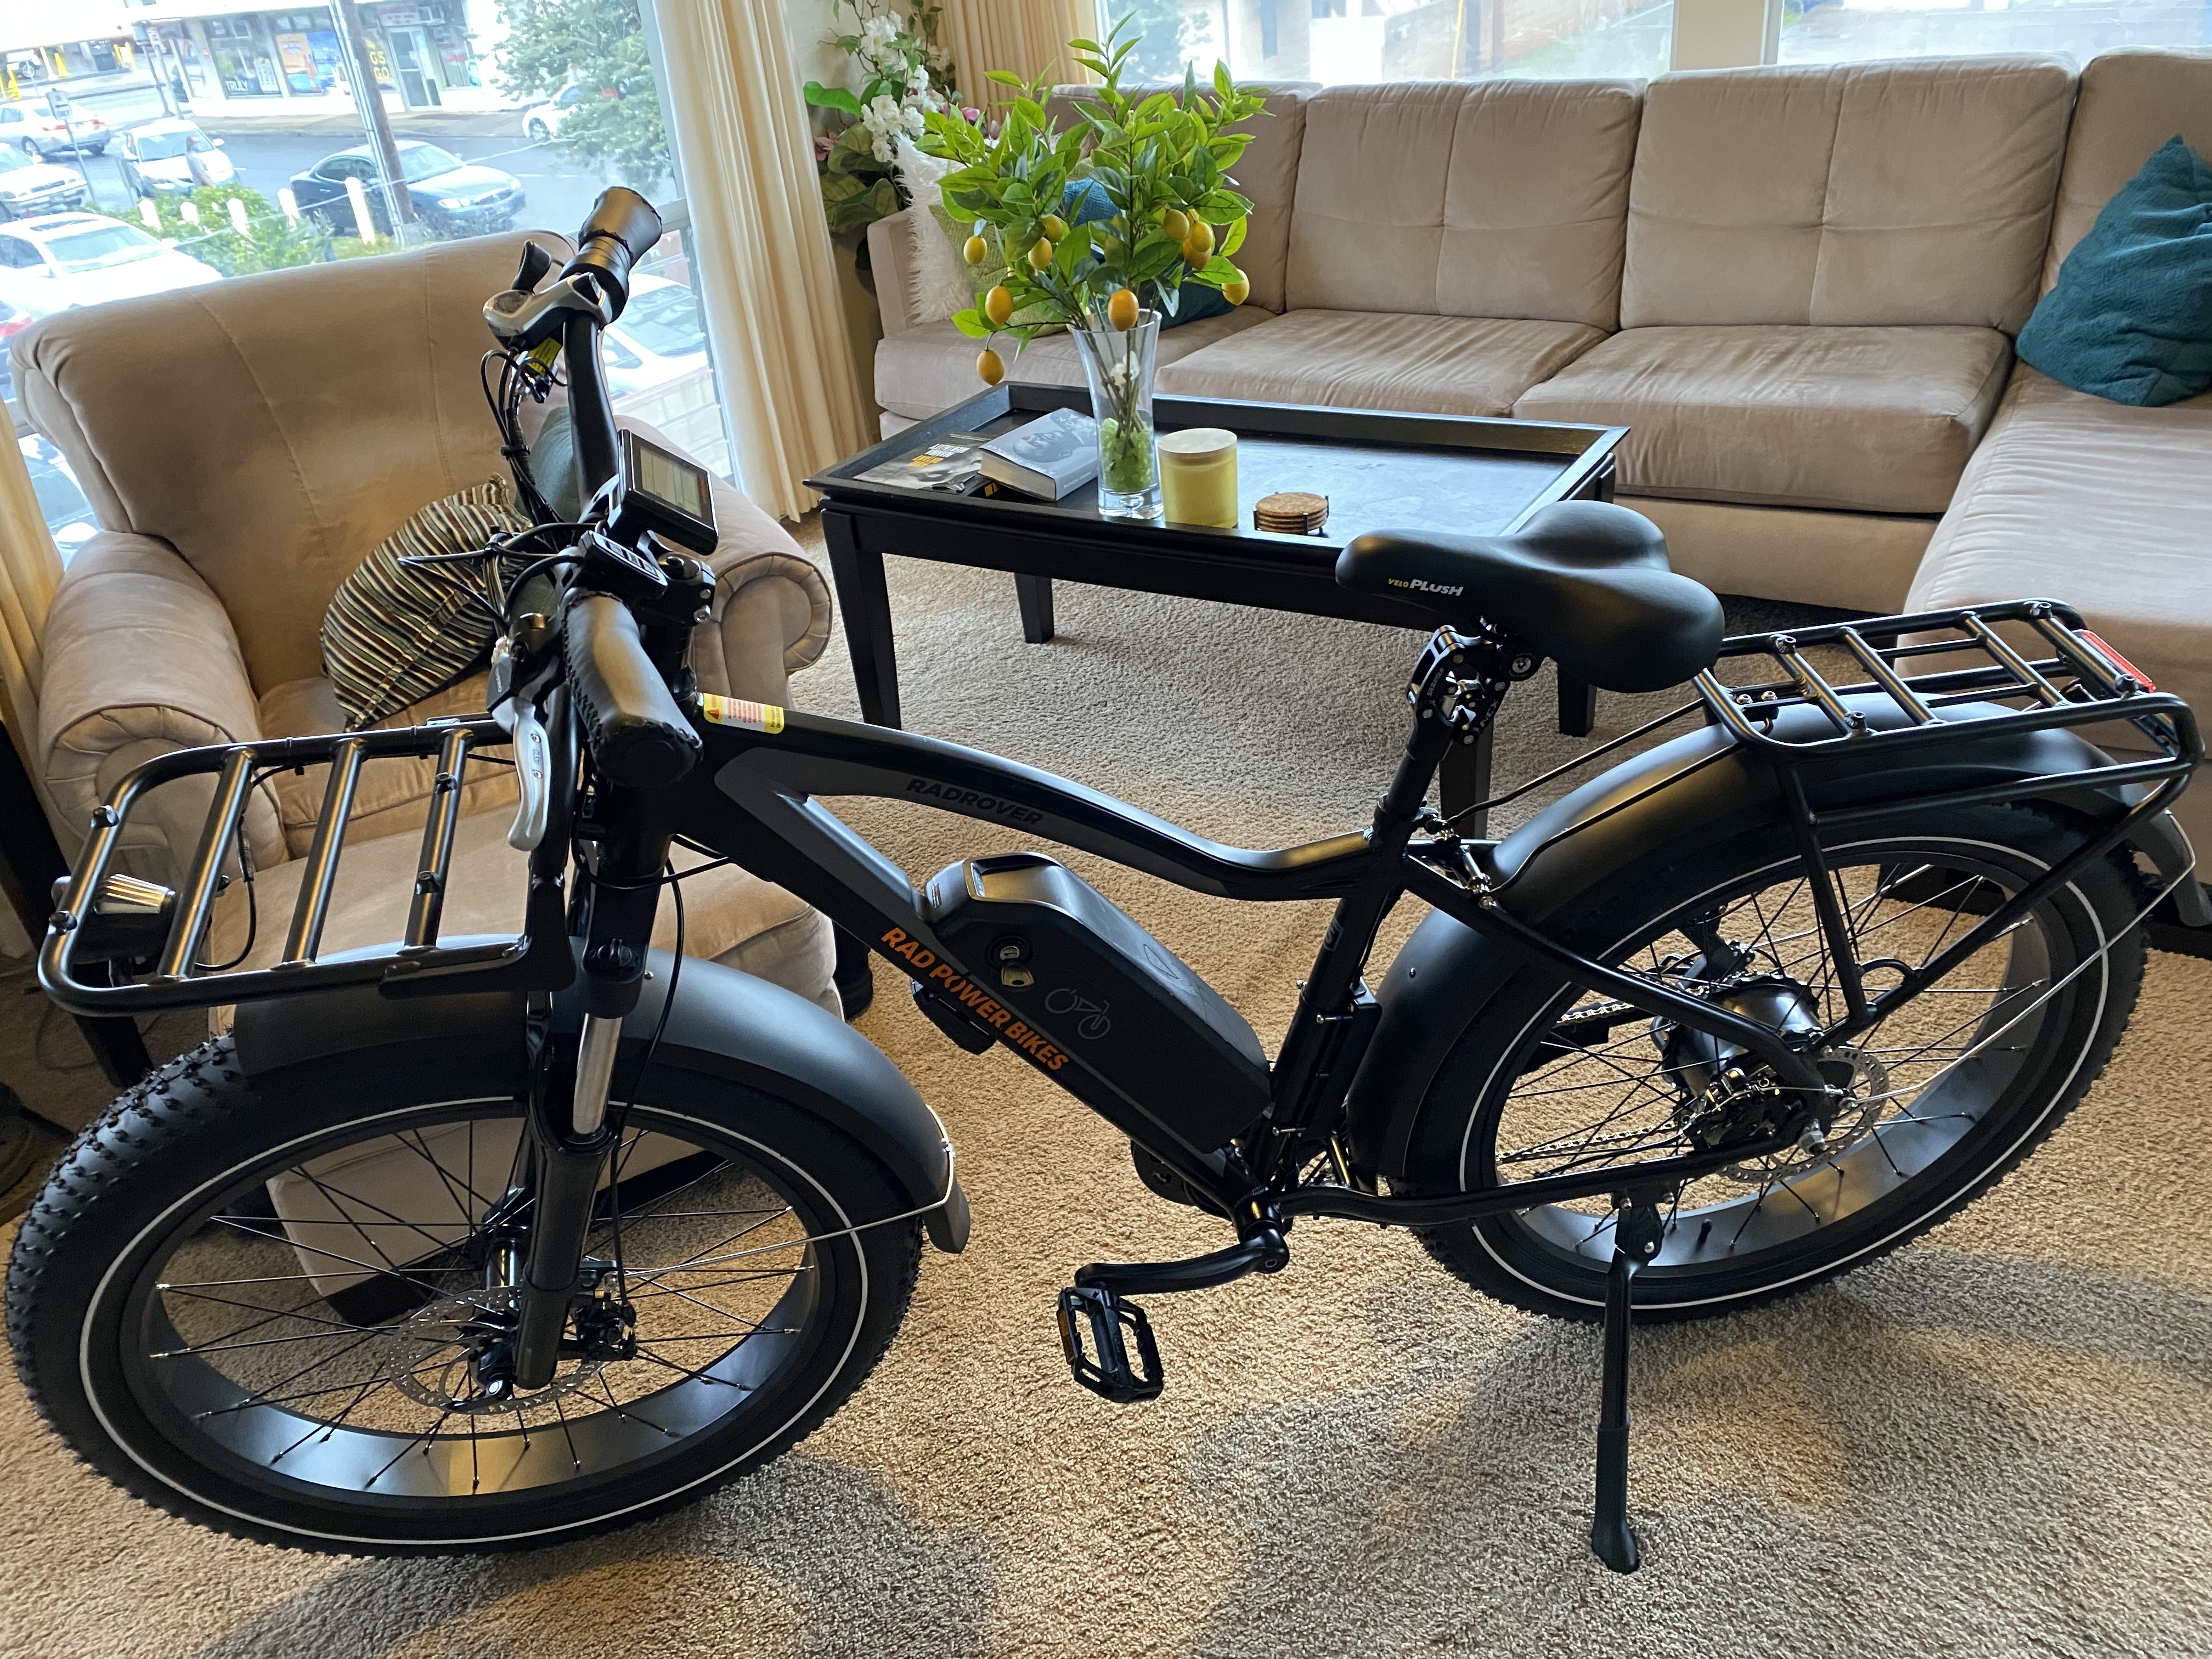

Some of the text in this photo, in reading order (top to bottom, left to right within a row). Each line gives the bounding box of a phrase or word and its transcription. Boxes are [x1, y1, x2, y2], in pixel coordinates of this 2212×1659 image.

[225, 80, 248, 92] TRULY
[1387, 578, 1464, 596] VELO PLUSH
[906, 778, 1043, 824] RADROVER
[881, 927, 1069, 1071] RAD POWER BIKES
